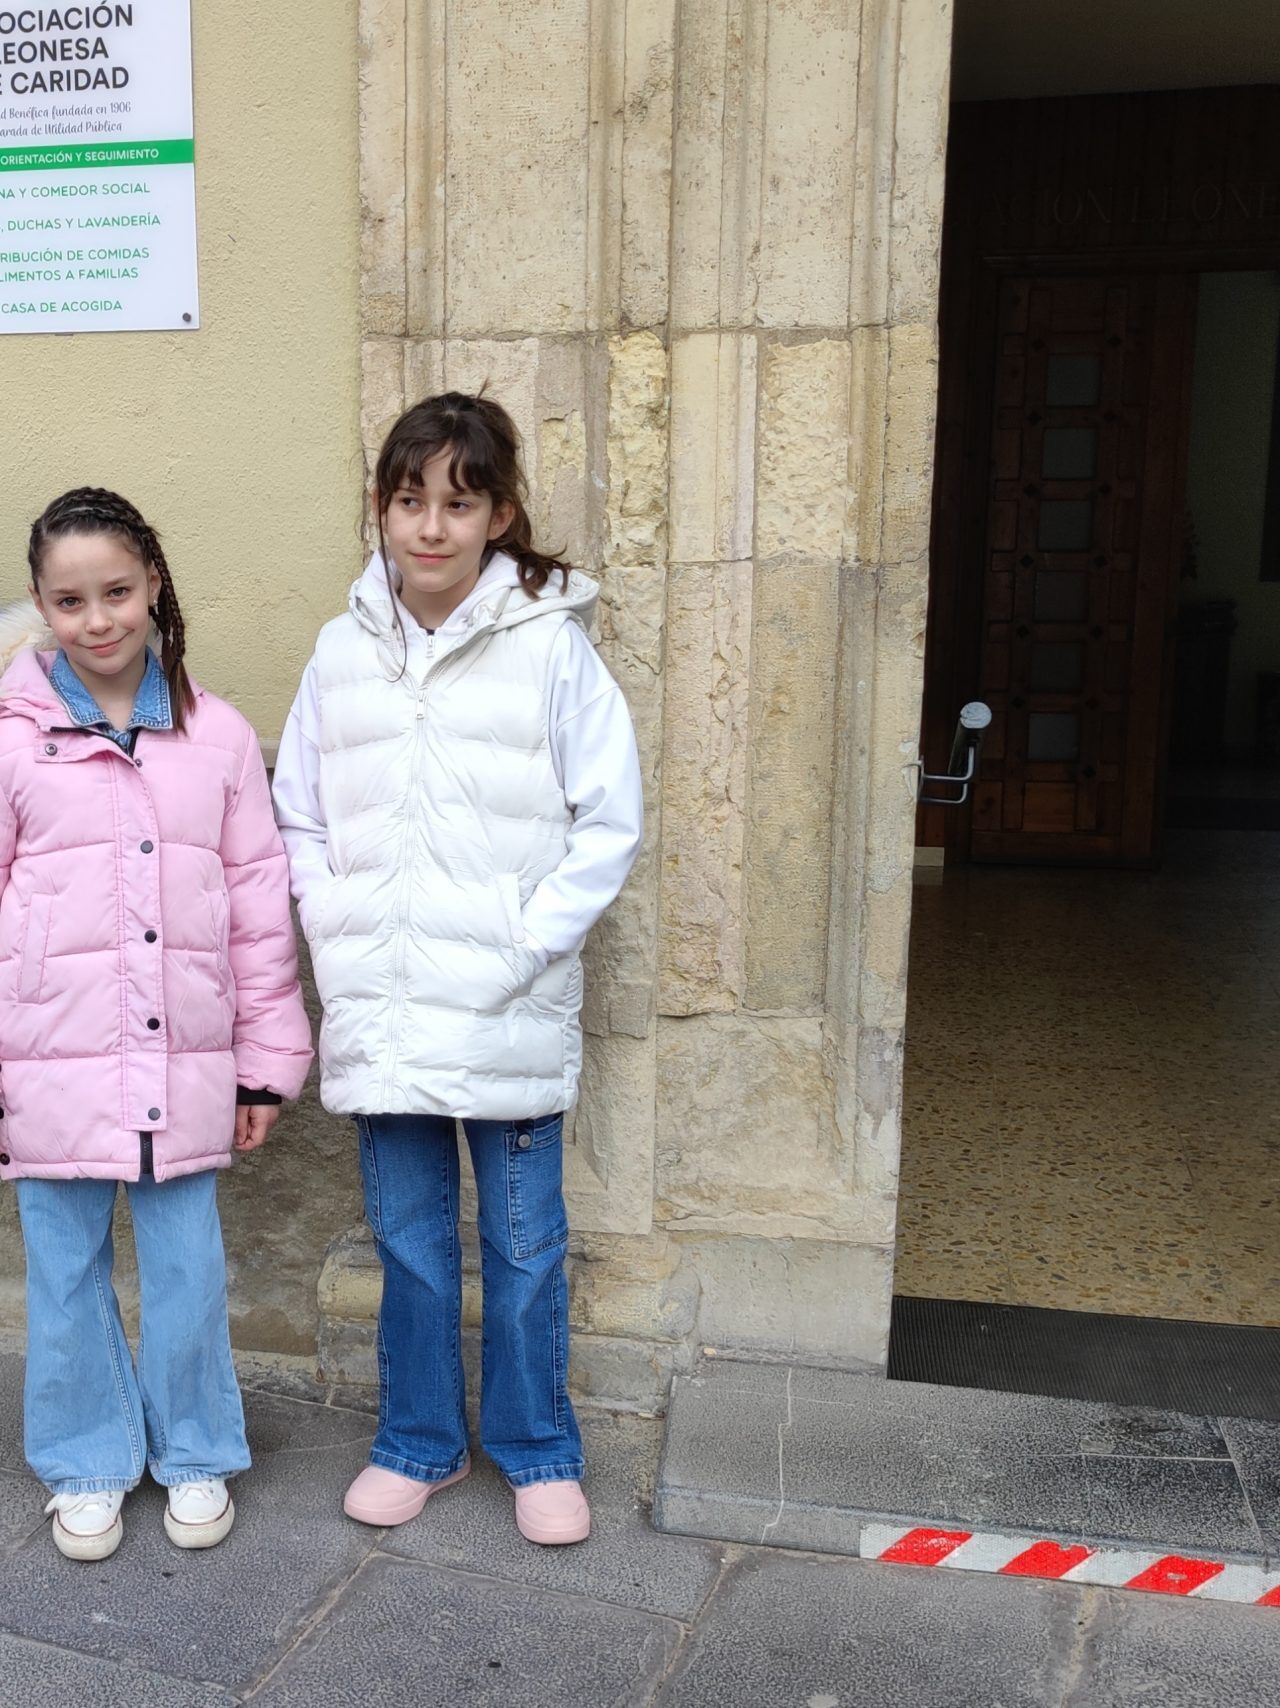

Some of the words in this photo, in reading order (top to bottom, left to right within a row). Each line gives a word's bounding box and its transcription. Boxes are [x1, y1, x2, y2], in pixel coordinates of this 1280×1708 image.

[10, 67, 130, 94] CARIDAD
[51, 104, 93, 119] fundada
[96, 106, 107, 115] en
[110, 102, 131, 113] 1906
[31, 124, 43, 136] de
[44, 122, 83, 135] Utilidad
[85, 120, 122, 133] Pública
[0, 151, 73, 165] ORIENTACIÓN
[75, 152, 83, 162] Y
[85, 149, 159, 161] SEGUIMIENTO
[18, 188, 27, 198] Y
[31, 185, 98, 198] COMEDOR
[101, 183, 150, 195] SOCIAL
[7, 218, 62, 231] DUCHAS
[65, 218, 74, 228] Y
[77, 212, 161, 228] LAVANDERÍA
[67, 250, 84, 261] DE
[88, 248, 150, 260] COMIDAS
[65, 270, 75, 280] A
[78, 267, 139, 280] FAMILIAS
[1, 302, 36, 313] CASA
[40, 302, 57, 312] DE
[61, 300, 123, 312] ACOGIDA
